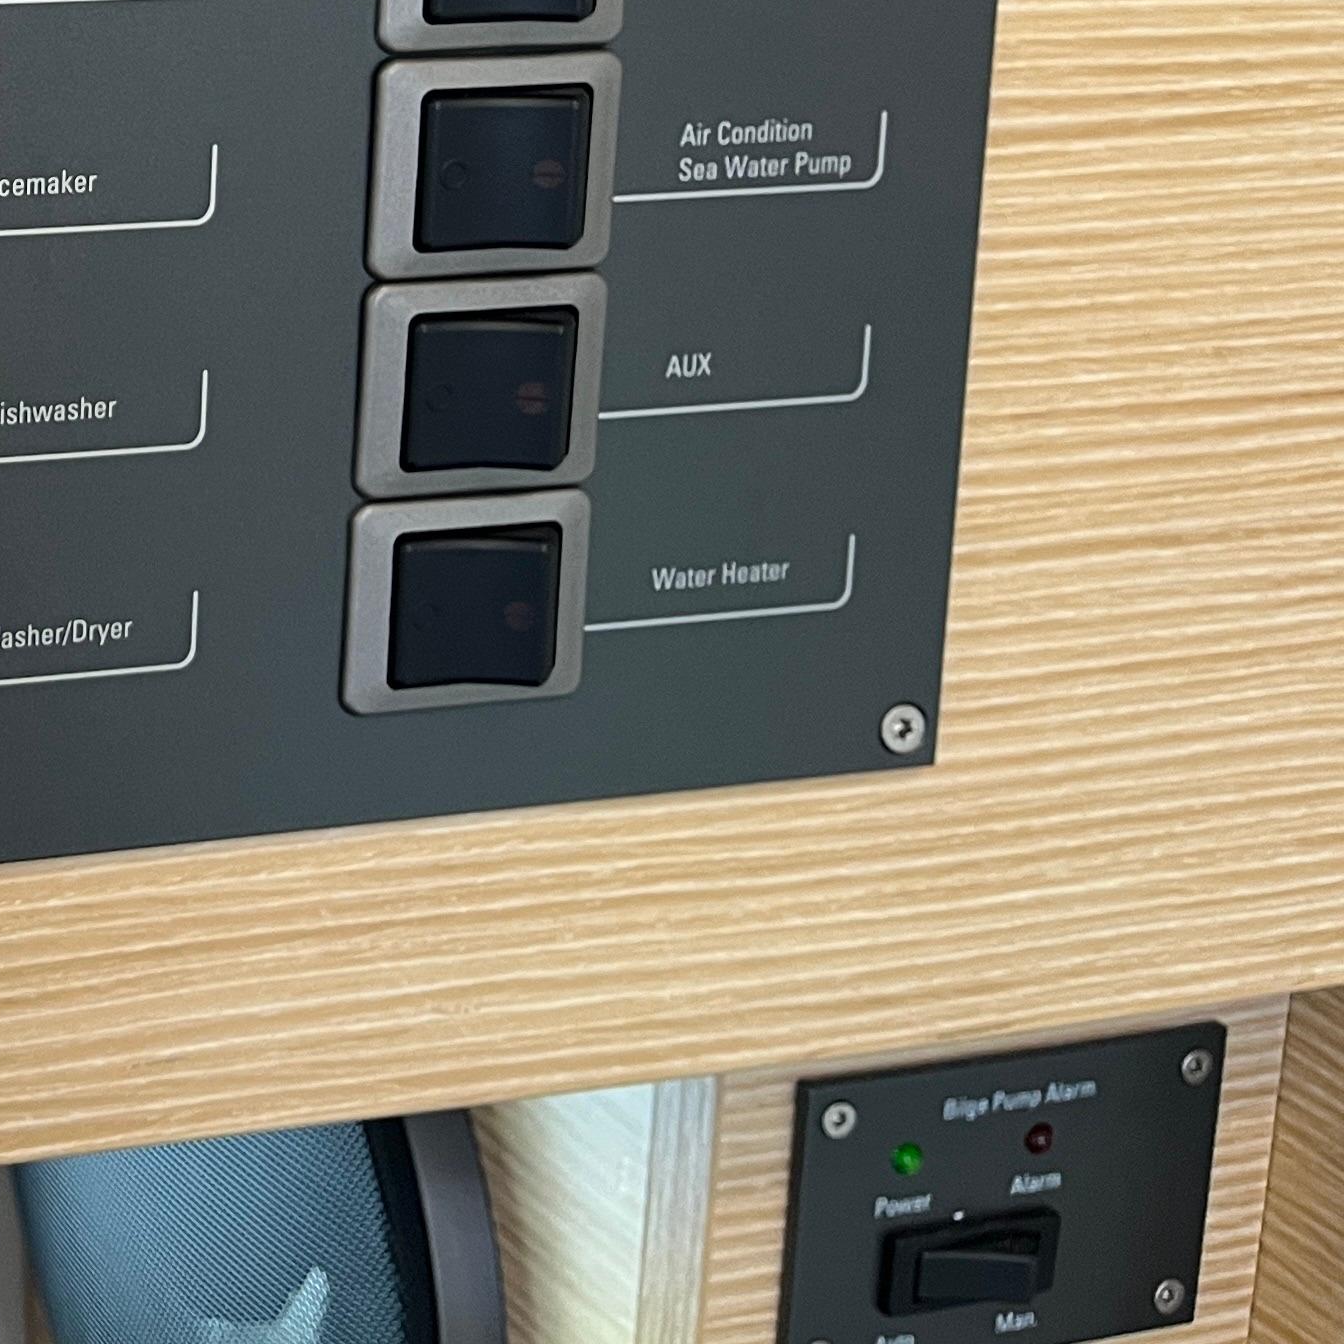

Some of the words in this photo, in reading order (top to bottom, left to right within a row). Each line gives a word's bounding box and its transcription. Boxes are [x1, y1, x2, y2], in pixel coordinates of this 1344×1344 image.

[680, 122, 712, 147] Air
[717, 118, 813, 146] Condition
[678, 157, 718, 182] Sea
[724, 154, 789, 179] Water
[794, 151, 852, 178] Pump
[665, 352, 712, 378] AUX
[651, 567, 716, 591] Water
[721, 561, 790, 585] Heater
